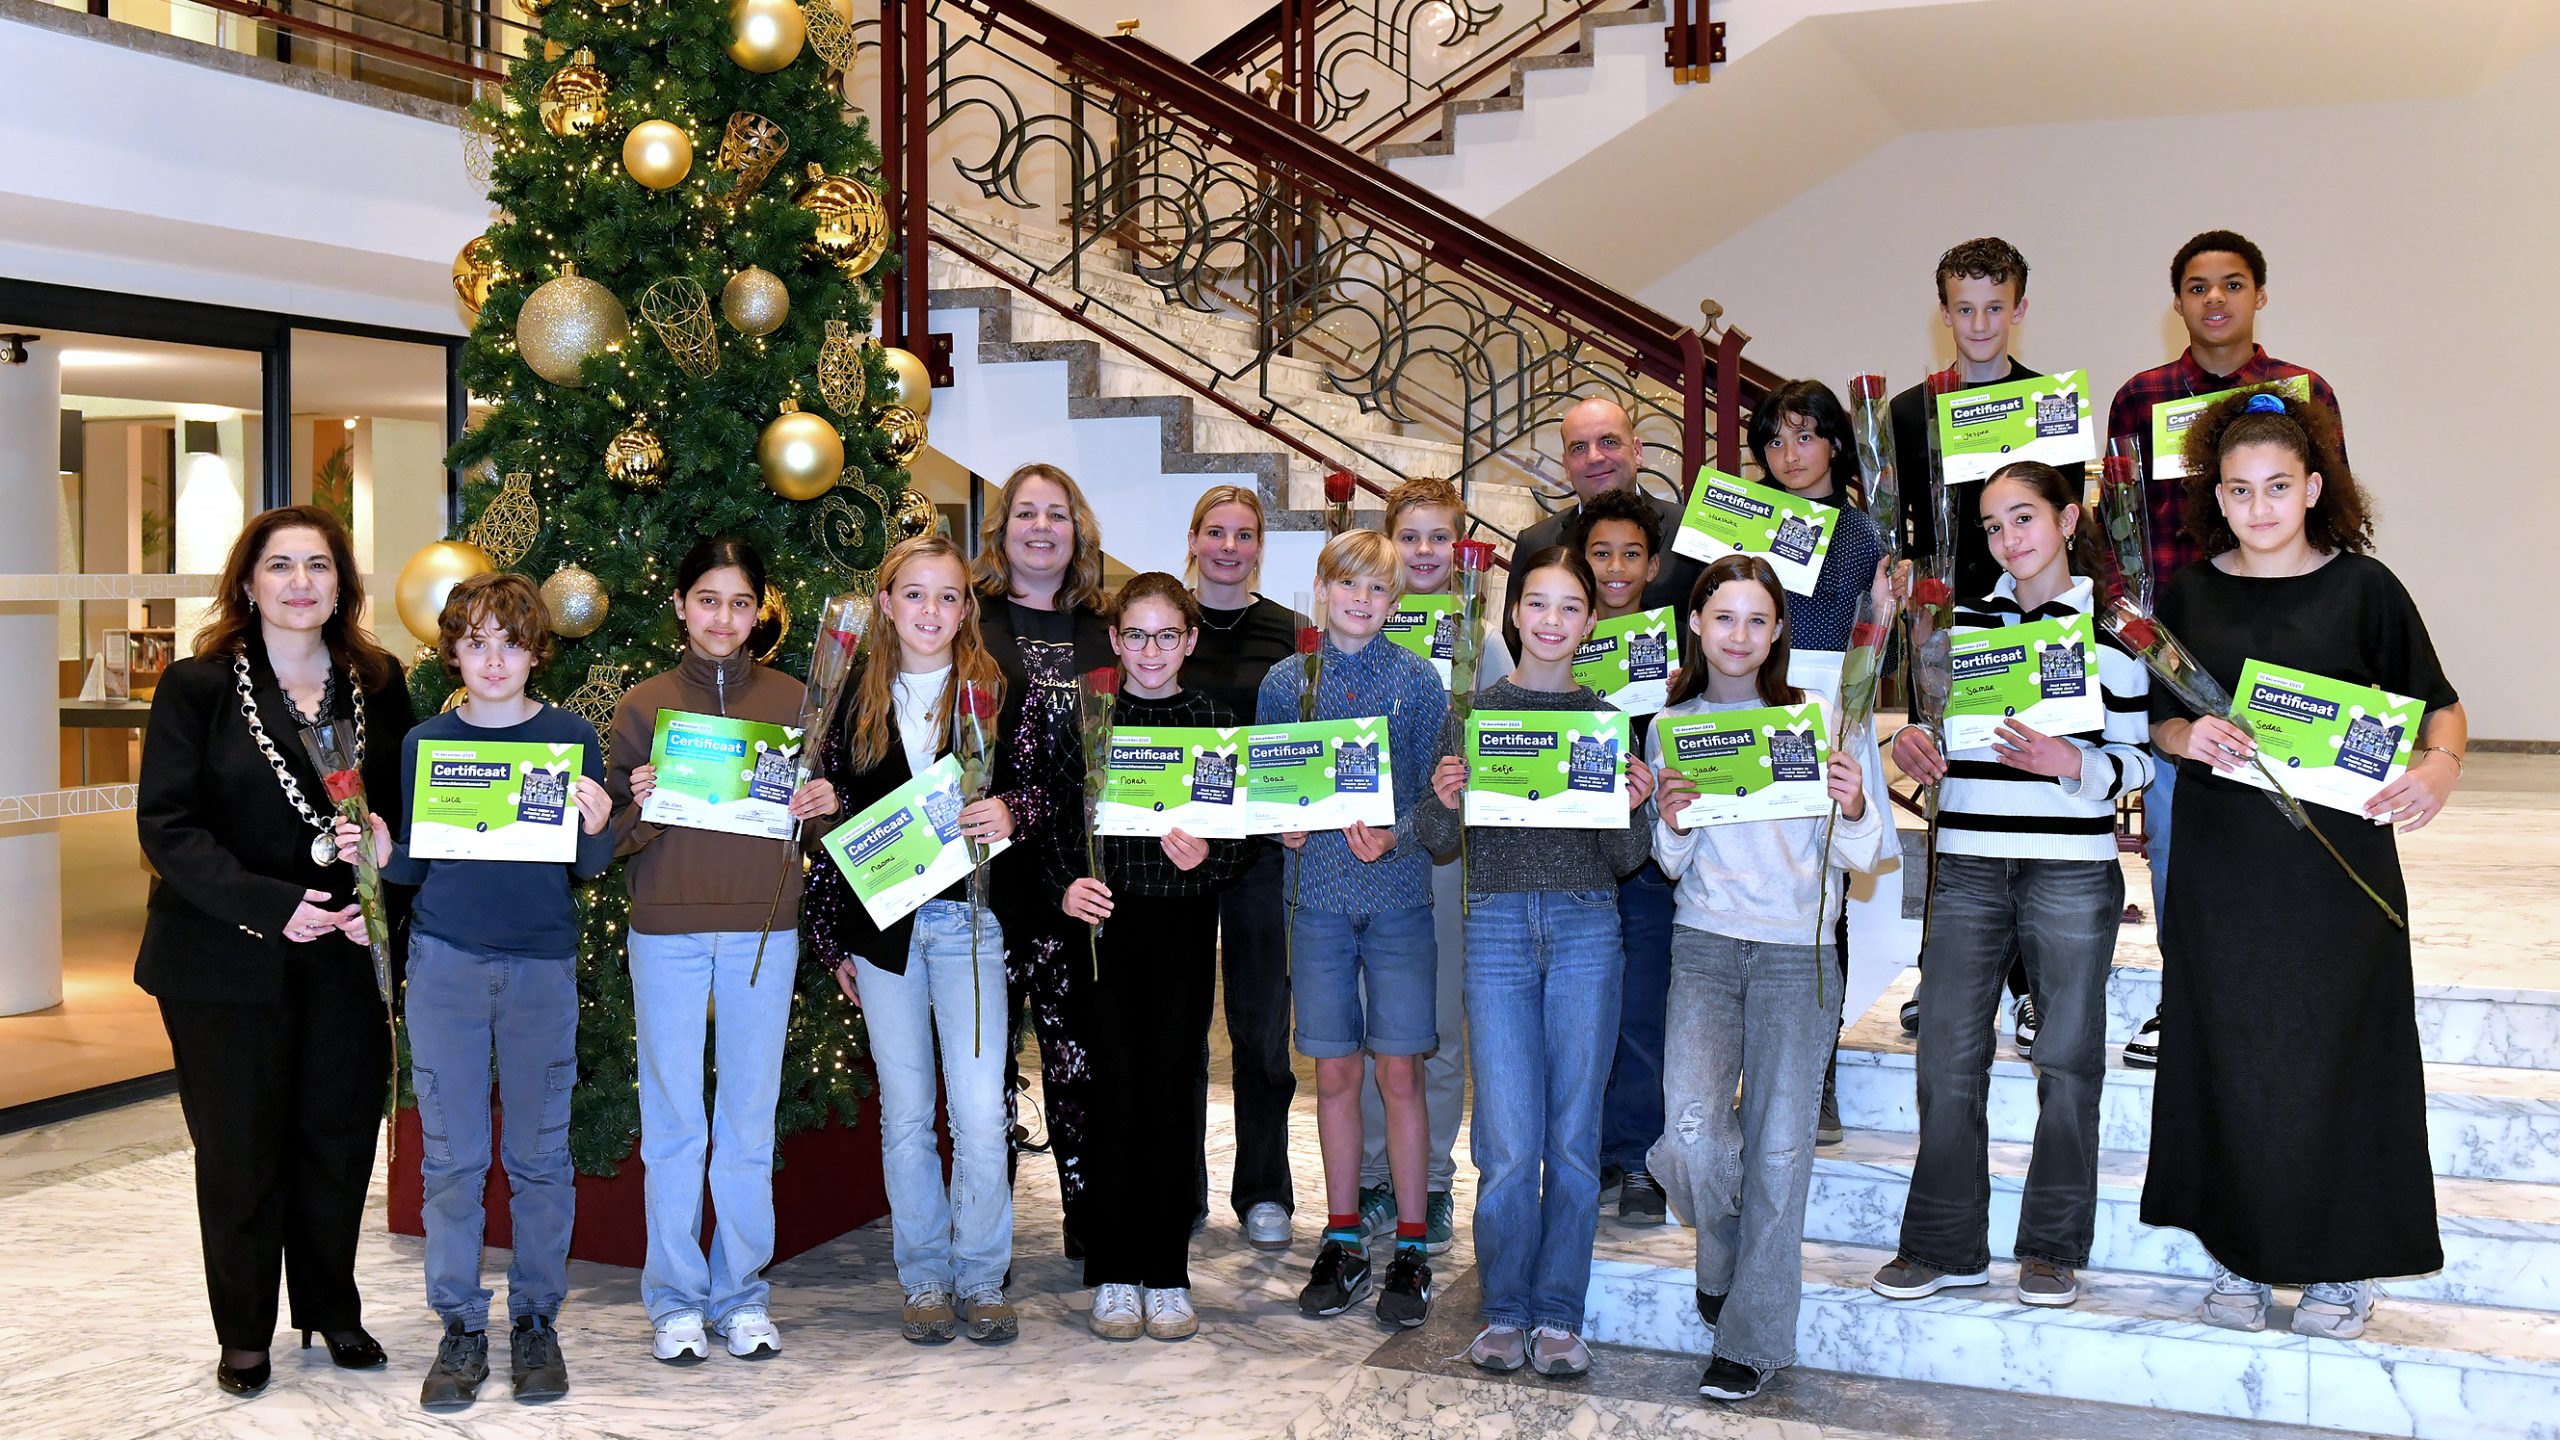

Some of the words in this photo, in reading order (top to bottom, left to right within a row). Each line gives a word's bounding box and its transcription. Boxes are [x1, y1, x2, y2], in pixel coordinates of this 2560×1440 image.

[1954, 400, 2021, 419] Certificaat
[2169, 413, 2200, 425] Cert
[1708, 489, 1771, 517] Certificaat
[1952, 650, 2023, 670] Certificaat
[2255, 688, 2335, 718] Certificaat
[2256, 719, 2283, 733] Sedra
[671, 735, 742, 754] Certificaat
[1482, 734, 1554, 746] Certificaat
[1678, 733, 1751, 750] Certificaat
[1113, 749, 1180, 761] Certificaat
[1251, 744, 1320, 758] Certificaat
[434, 764, 507, 778] Certificaat
[1492, 764, 1514, 775] Eefje
[1692, 765, 1719, 778] Jaade
[441, 795, 462, 804] Luca
[848, 811, 910, 856] Certificaat
[870, 855, 896, 874] Naomi
